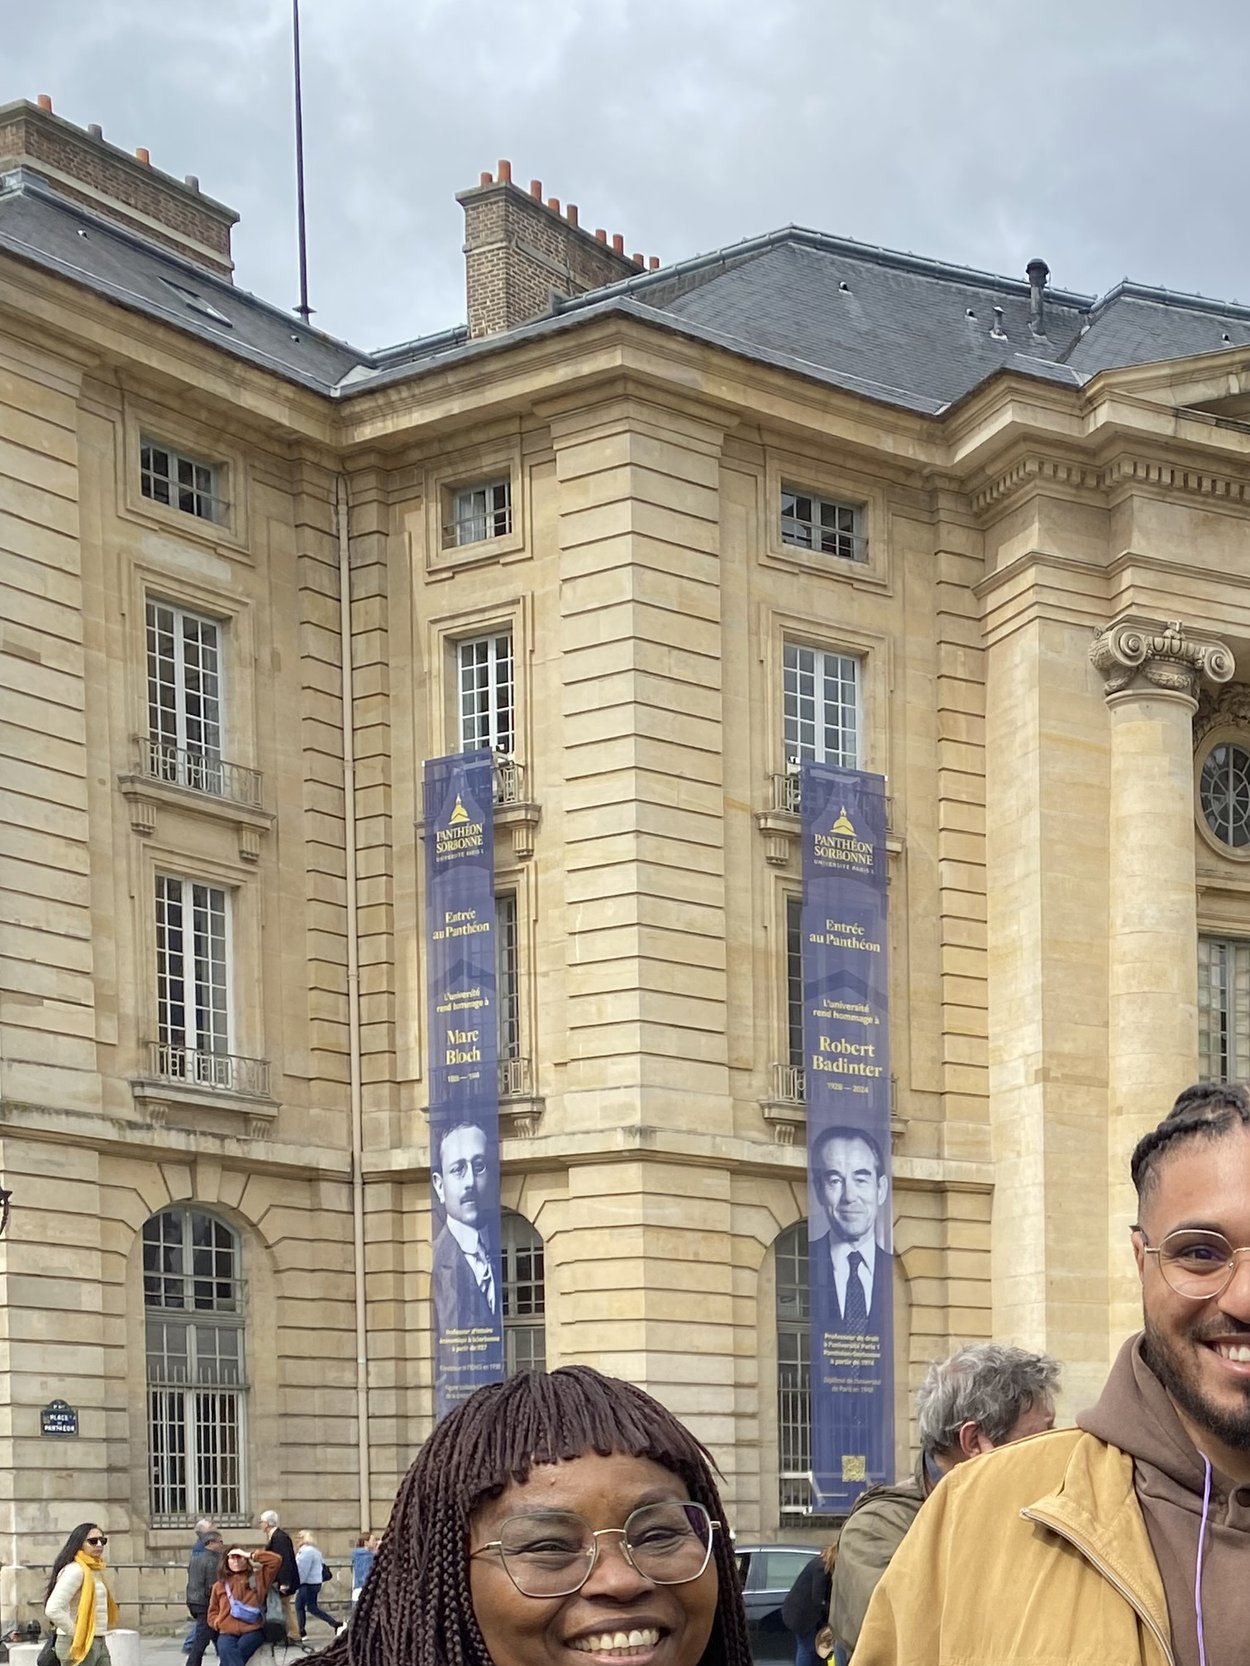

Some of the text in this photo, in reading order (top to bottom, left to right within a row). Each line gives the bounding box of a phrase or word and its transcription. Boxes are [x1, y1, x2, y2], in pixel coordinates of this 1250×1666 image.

[436, 835, 484, 854] SORBONNE
[814, 845, 874, 866] SORBONNE
[445, 908, 476, 924] Entrée
[432, 921, 490, 940] au Panthéon
[826, 919, 865, 935] Entrée
[809, 933, 881, 952] au Panthéon
[813, 1009, 831, 1018] rend
[833, 1010, 873, 1025] hommage
[447, 1029, 479, 1045] Marc
[819, 1035, 875, 1057] Robert
[446, 1045, 481, 1065] Bloch
[812, 1054, 882, 1078] Badinter
